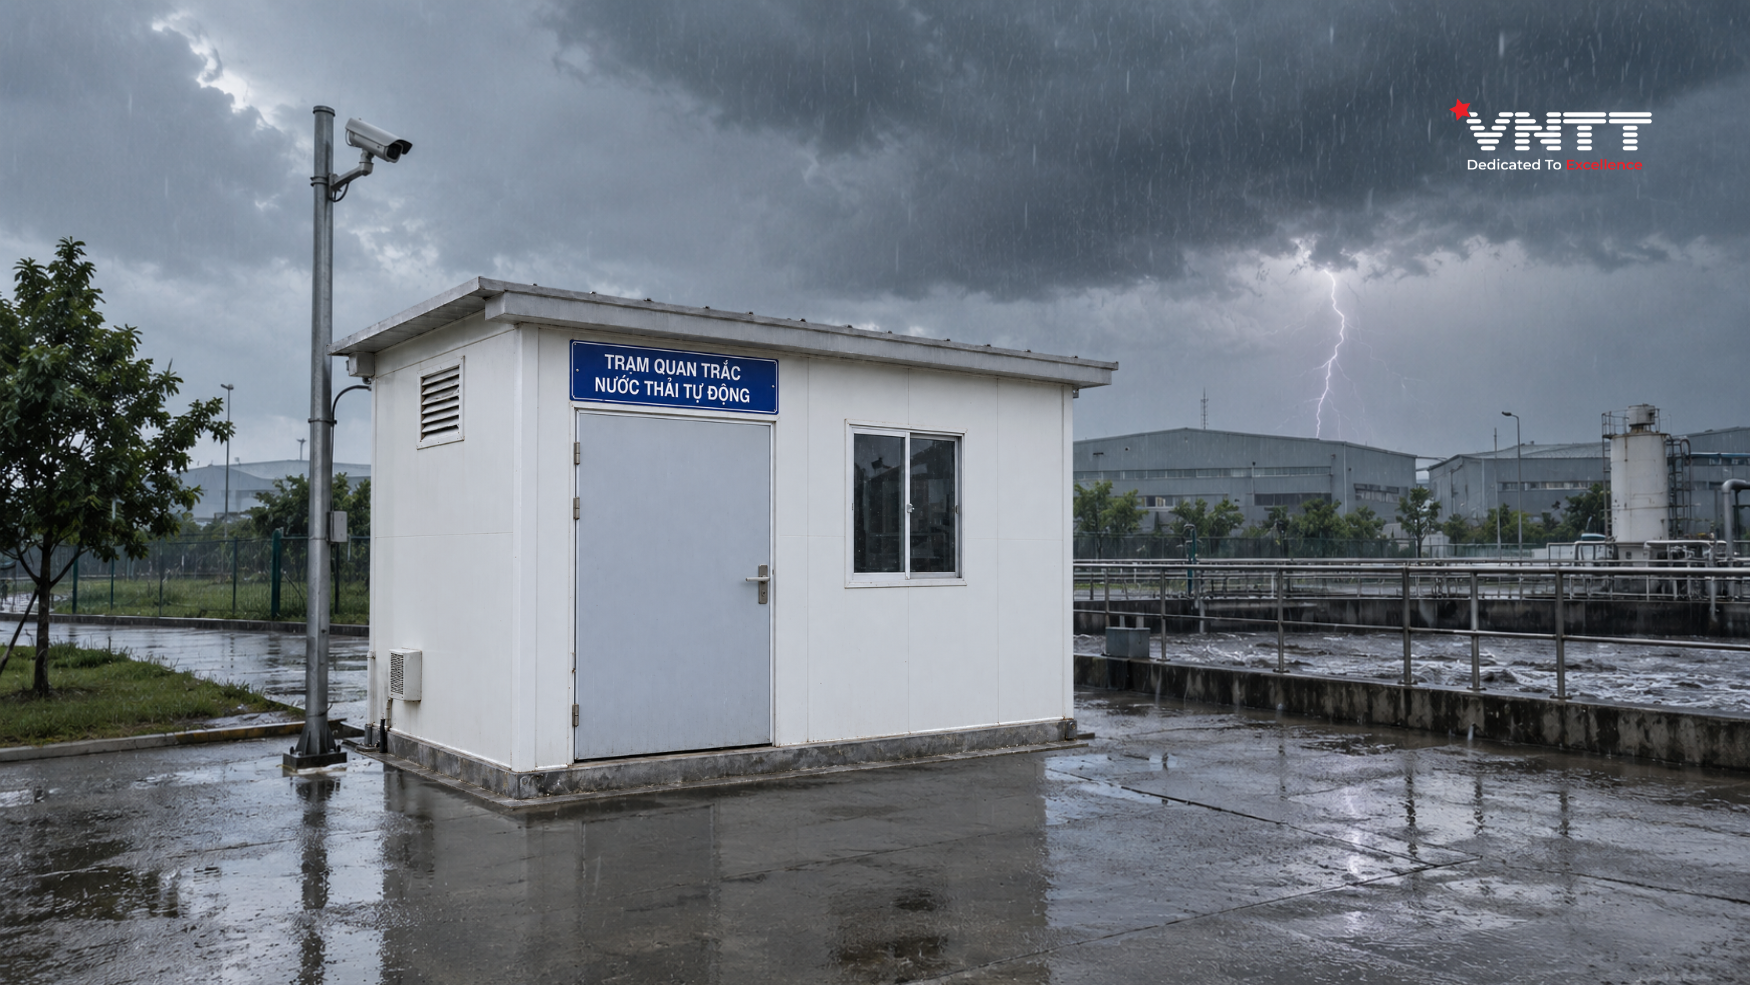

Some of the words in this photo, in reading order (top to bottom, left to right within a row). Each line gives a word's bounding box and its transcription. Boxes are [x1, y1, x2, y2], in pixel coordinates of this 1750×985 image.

[604, 354, 649, 375] TRẠM
[654, 358, 697, 377] QUAN
[701, 360, 741, 381] TRẮC
[595, 375, 640, 395] NƯỚC
[644, 377, 679, 398] THẢI
[683, 383, 704, 403] TỰ
[707, 383, 750, 405] ĐỘNG
